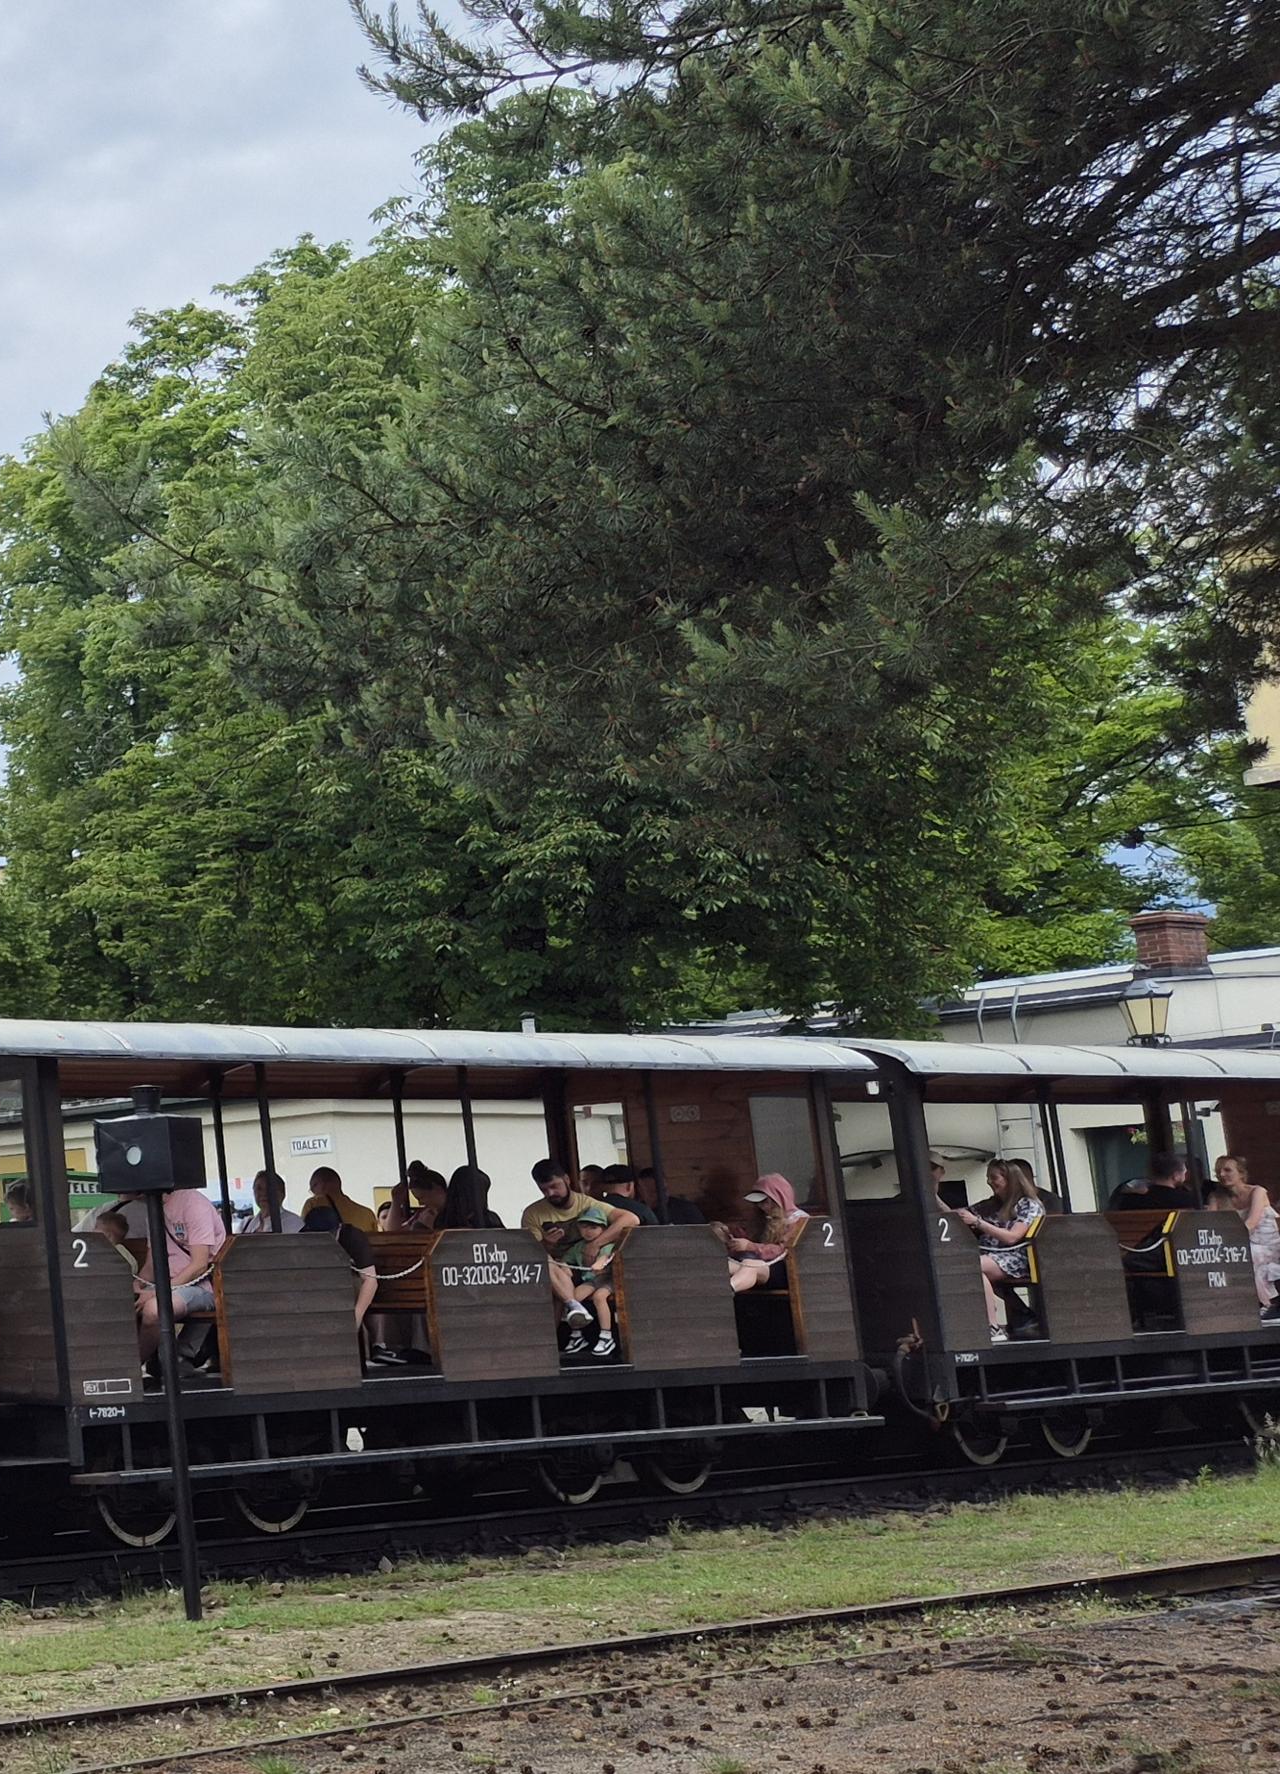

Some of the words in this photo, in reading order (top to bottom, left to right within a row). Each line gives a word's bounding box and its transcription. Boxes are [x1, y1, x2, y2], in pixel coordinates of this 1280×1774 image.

[292, 1139, 328, 1151] TOALETY
[822, 1222, 835, 1247] 2
[938, 1218, 951, 1242] 2
[72, 1238, 89, 1268] 2
[442, 1264, 542, 1286] 00-320034-314-7
